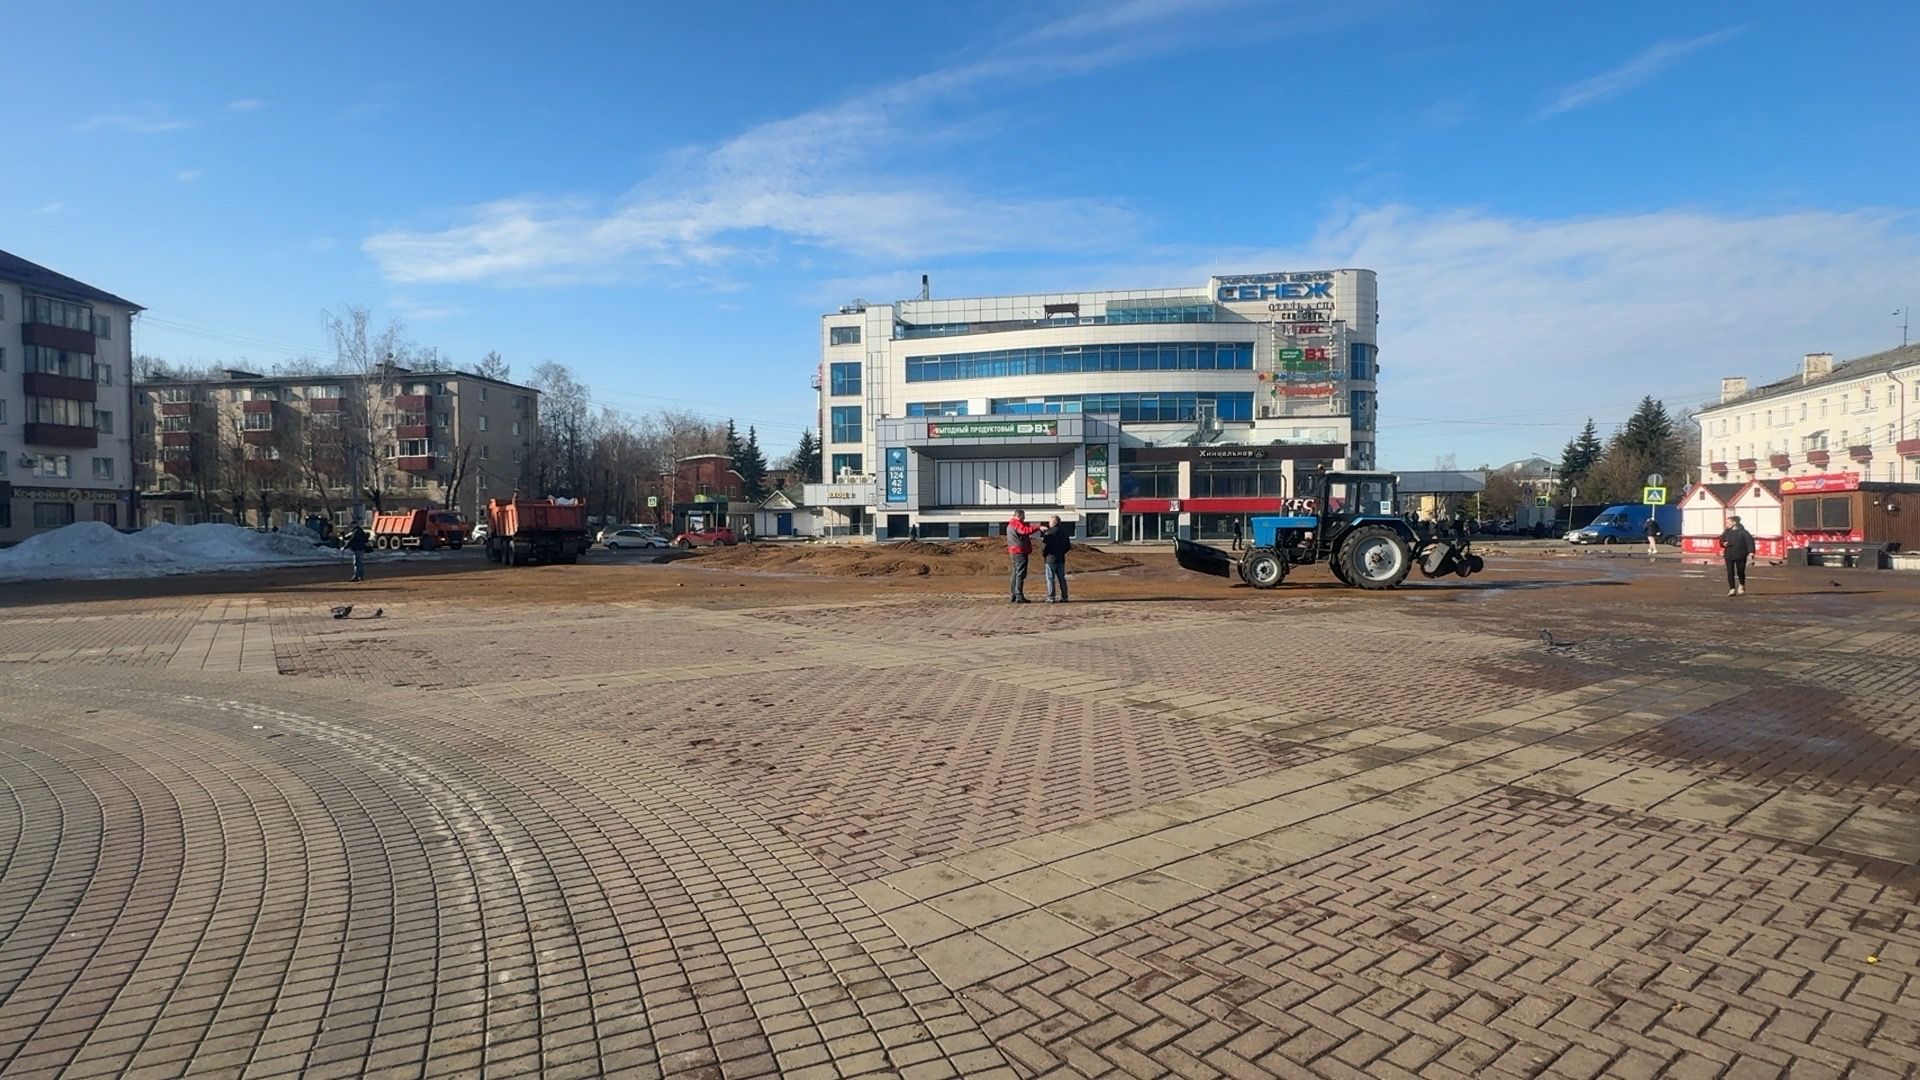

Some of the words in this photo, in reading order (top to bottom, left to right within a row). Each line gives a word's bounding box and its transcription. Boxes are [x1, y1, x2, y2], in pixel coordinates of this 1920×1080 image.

[1217, 282, 1333, 302] СЕНЕЖ
[970, 424, 1015, 434] ПРОДУКТОВЫЙ
[1281, 499, 1314, 511] KFC
